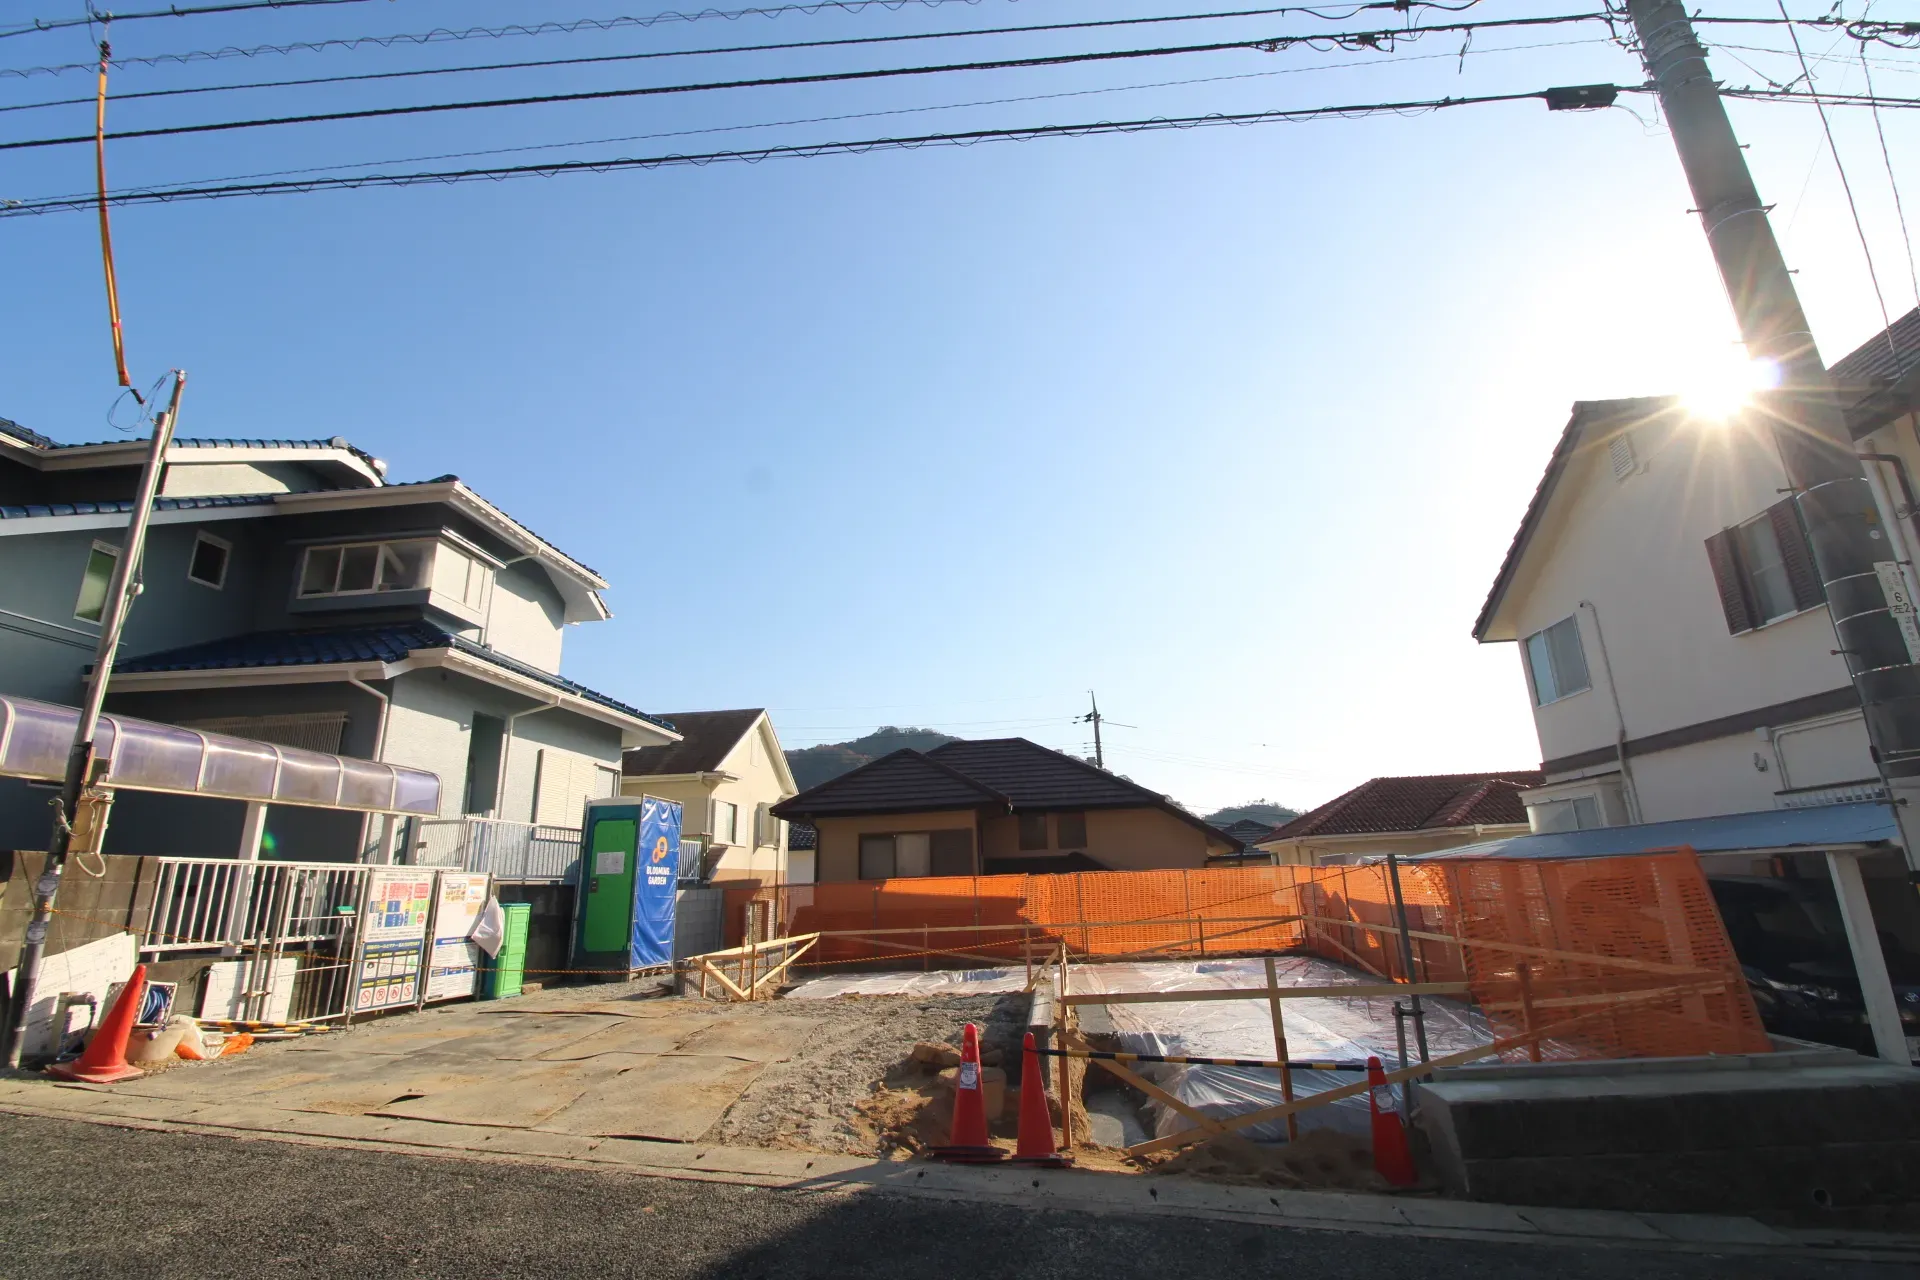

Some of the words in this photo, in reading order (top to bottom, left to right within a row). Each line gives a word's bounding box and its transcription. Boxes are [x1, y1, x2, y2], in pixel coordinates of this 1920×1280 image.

[1894, 592, 1903, 602] 6
[646, 866, 670, 876] BLOOMING
[648, 876, 667, 885] GARDEN
